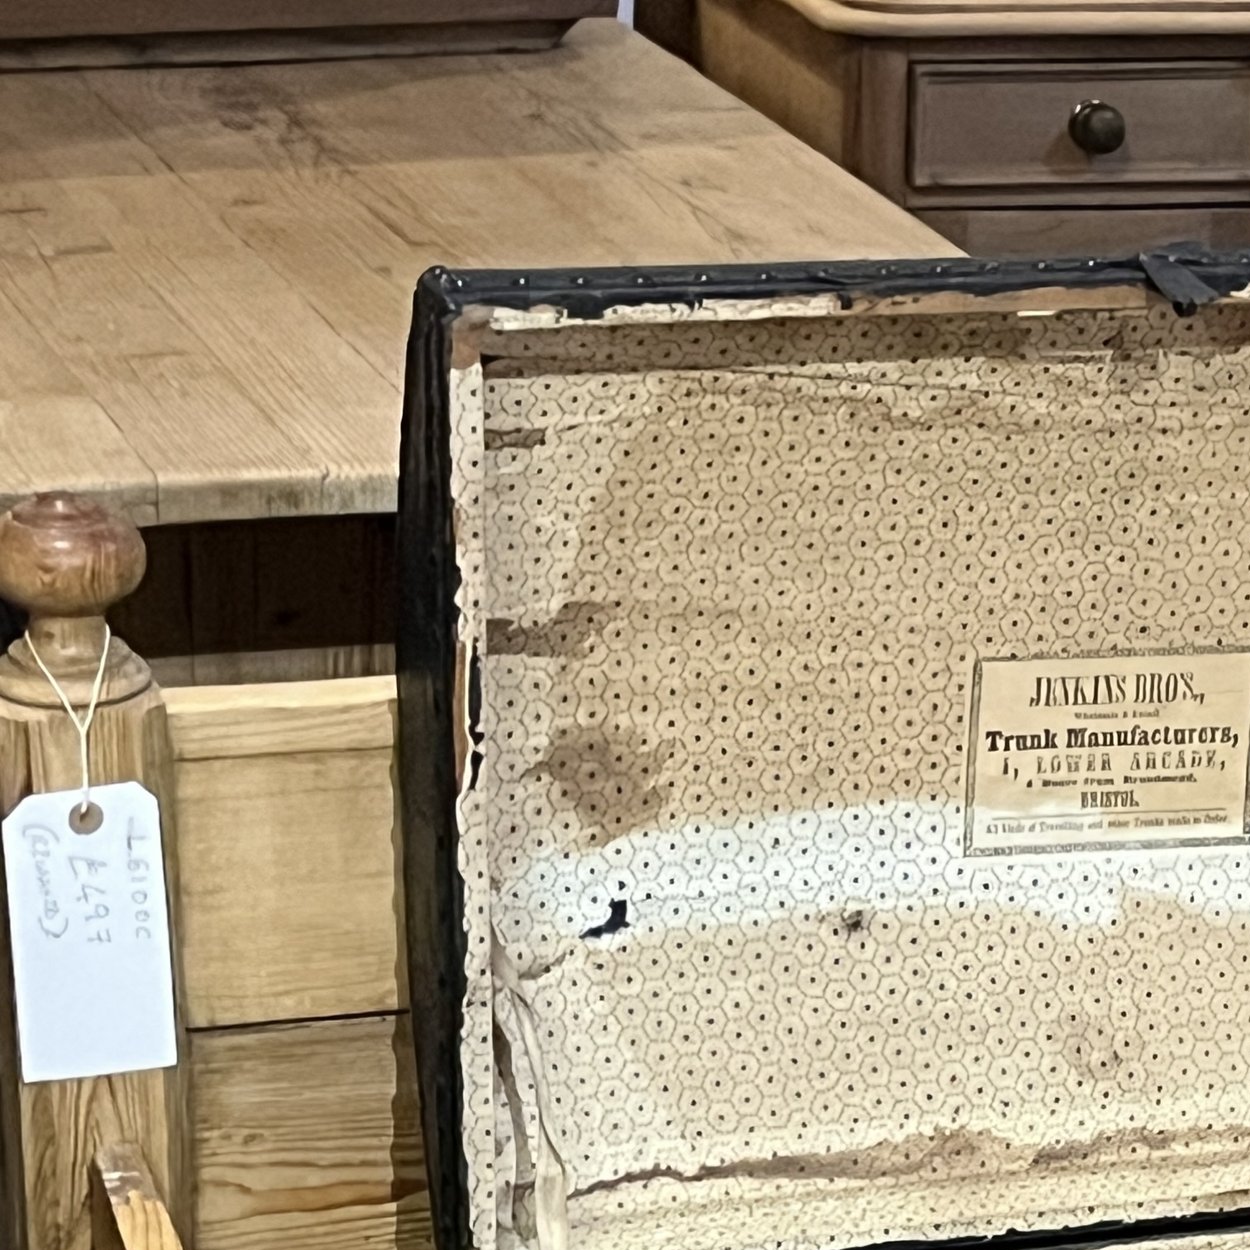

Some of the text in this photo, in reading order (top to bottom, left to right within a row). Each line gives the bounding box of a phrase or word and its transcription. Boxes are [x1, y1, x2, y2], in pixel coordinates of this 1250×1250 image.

[1029, 675, 1126, 707] JENKINS
[985, 724, 1239, 752] Trunk Manufacturers,
[1036, 753, 1112, 775] LOWER
[1130, 749, 1226, 772] ARCADE,
